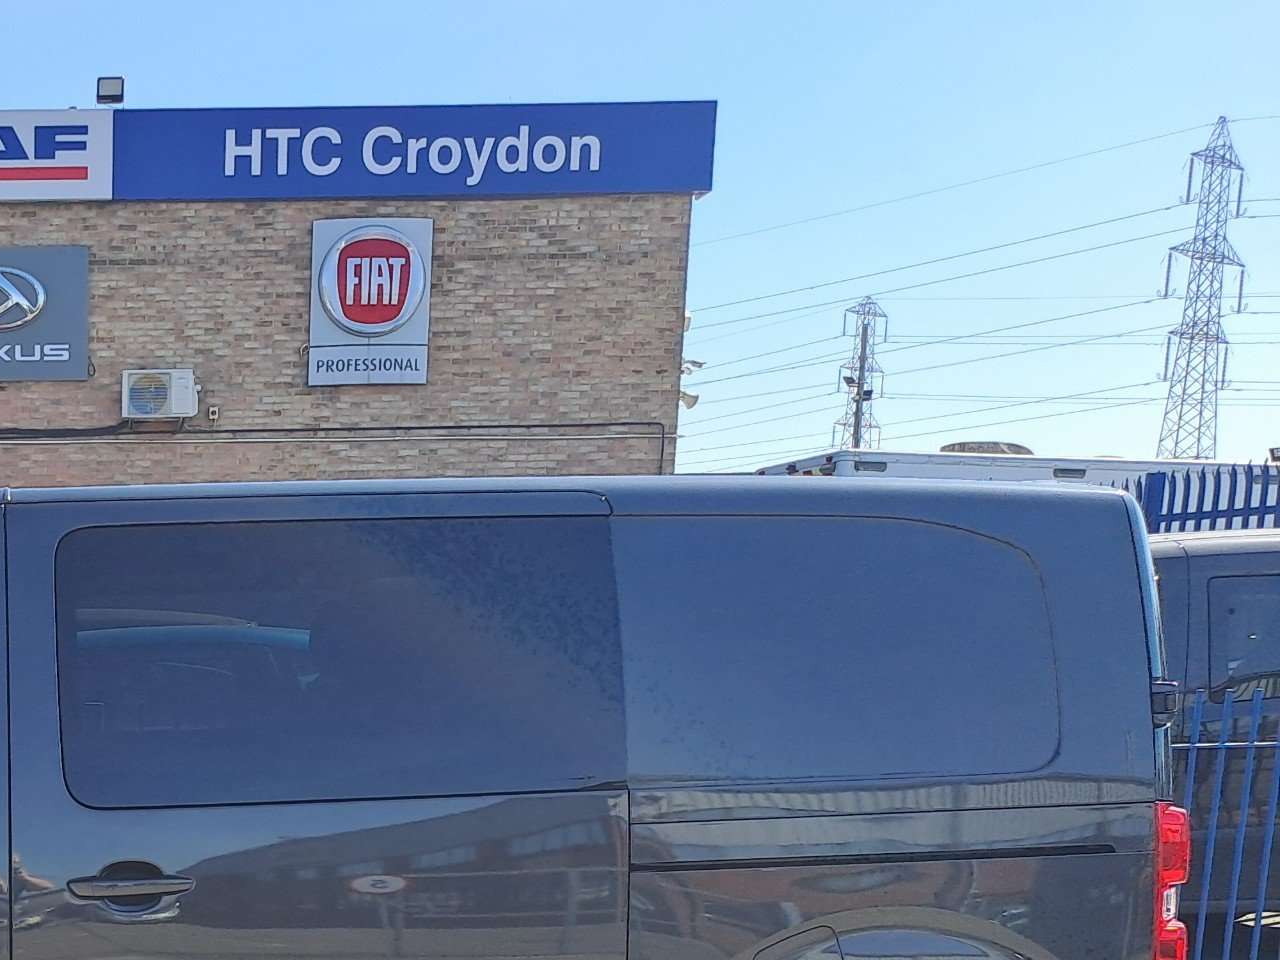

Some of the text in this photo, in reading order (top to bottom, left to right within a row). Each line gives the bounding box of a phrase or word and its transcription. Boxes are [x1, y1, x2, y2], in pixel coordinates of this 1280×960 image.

[224, 125, 601, 187] HTC Croydon
[346, 257, 406, 305] FIAT
[316, 358, 421, 373] PROFESSIONAL
